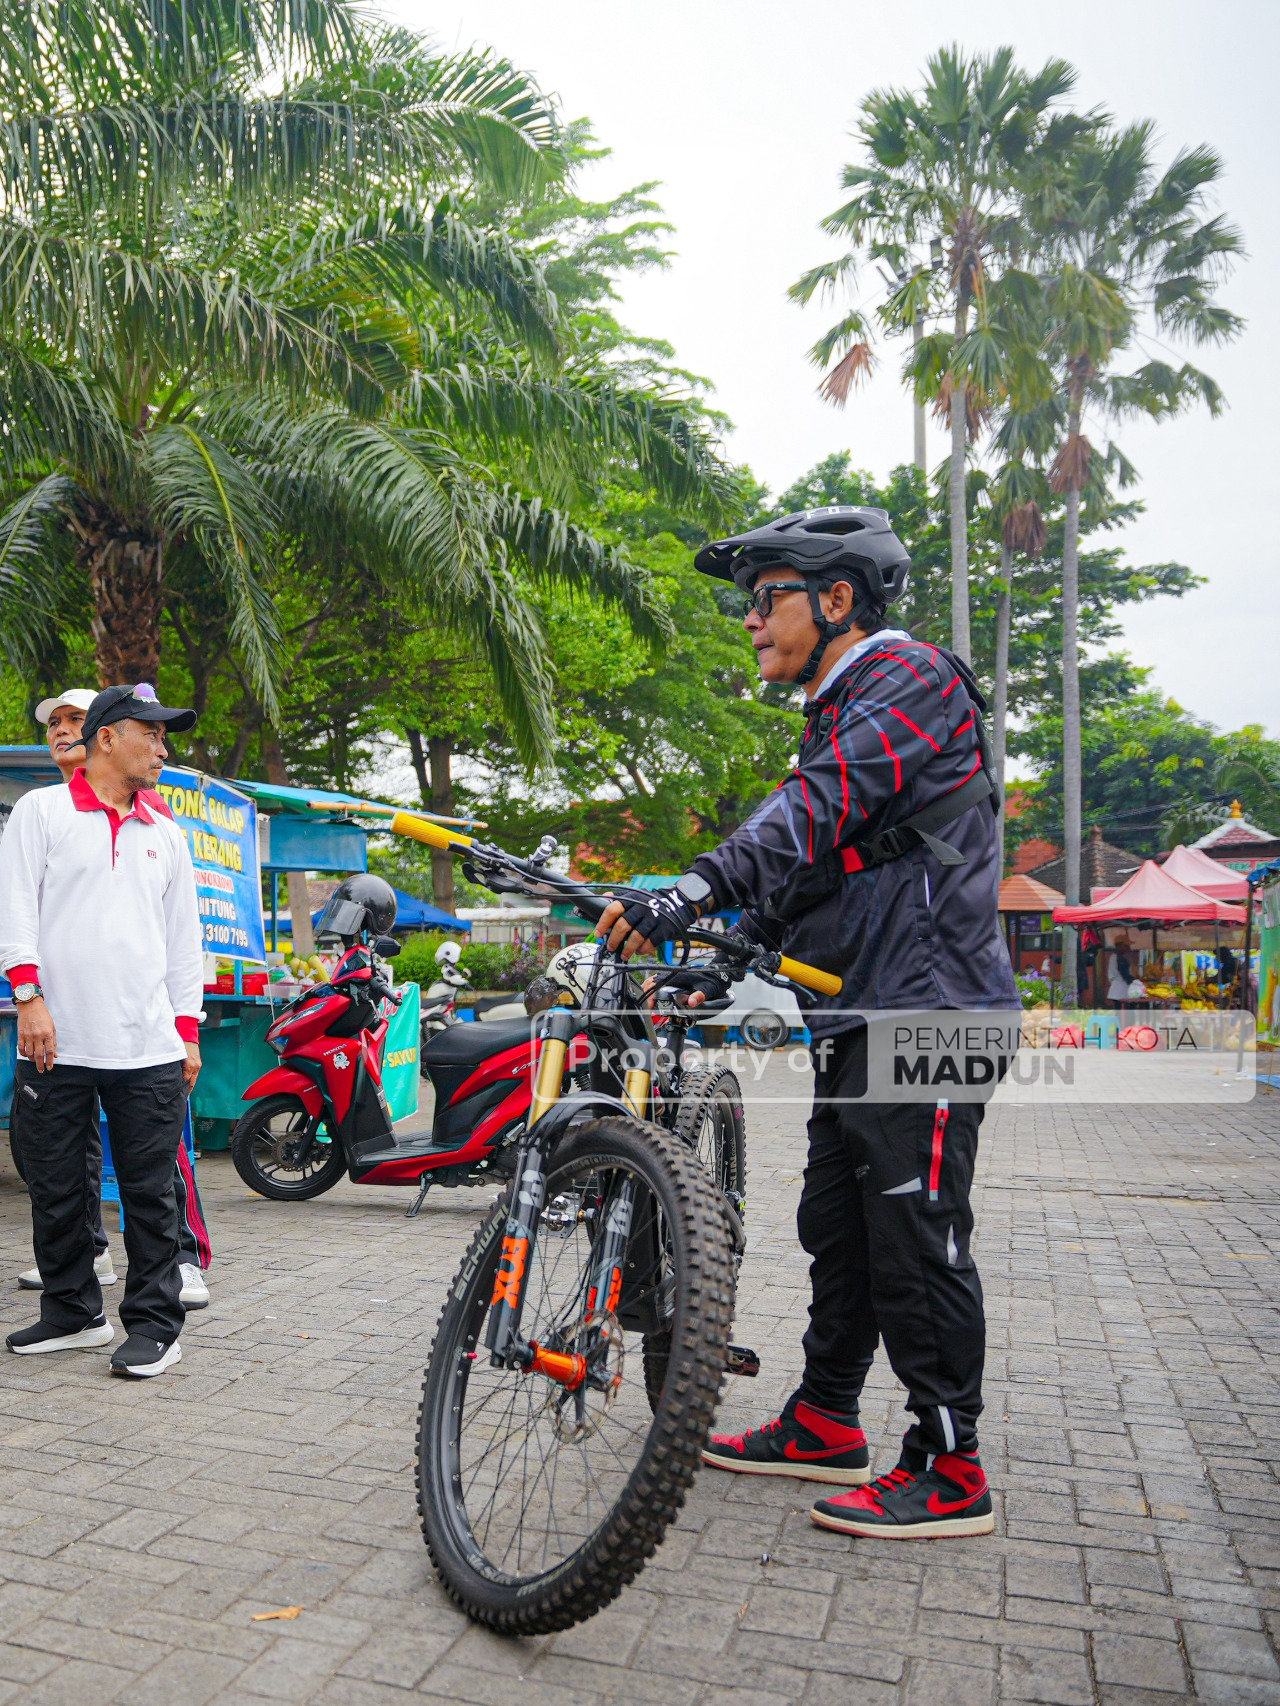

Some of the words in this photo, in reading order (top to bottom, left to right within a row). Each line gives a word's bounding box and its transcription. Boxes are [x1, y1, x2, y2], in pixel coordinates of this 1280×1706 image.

[806, 506, 861, 519] FOX
[155, 784, 209, 822] TONG
[209, 796, 245, 835] BALAP
[192, 829, 243, 873] KERANG
[205, 923, 230, 944] 3100
[491, 1235, 529, 1310] FOX
